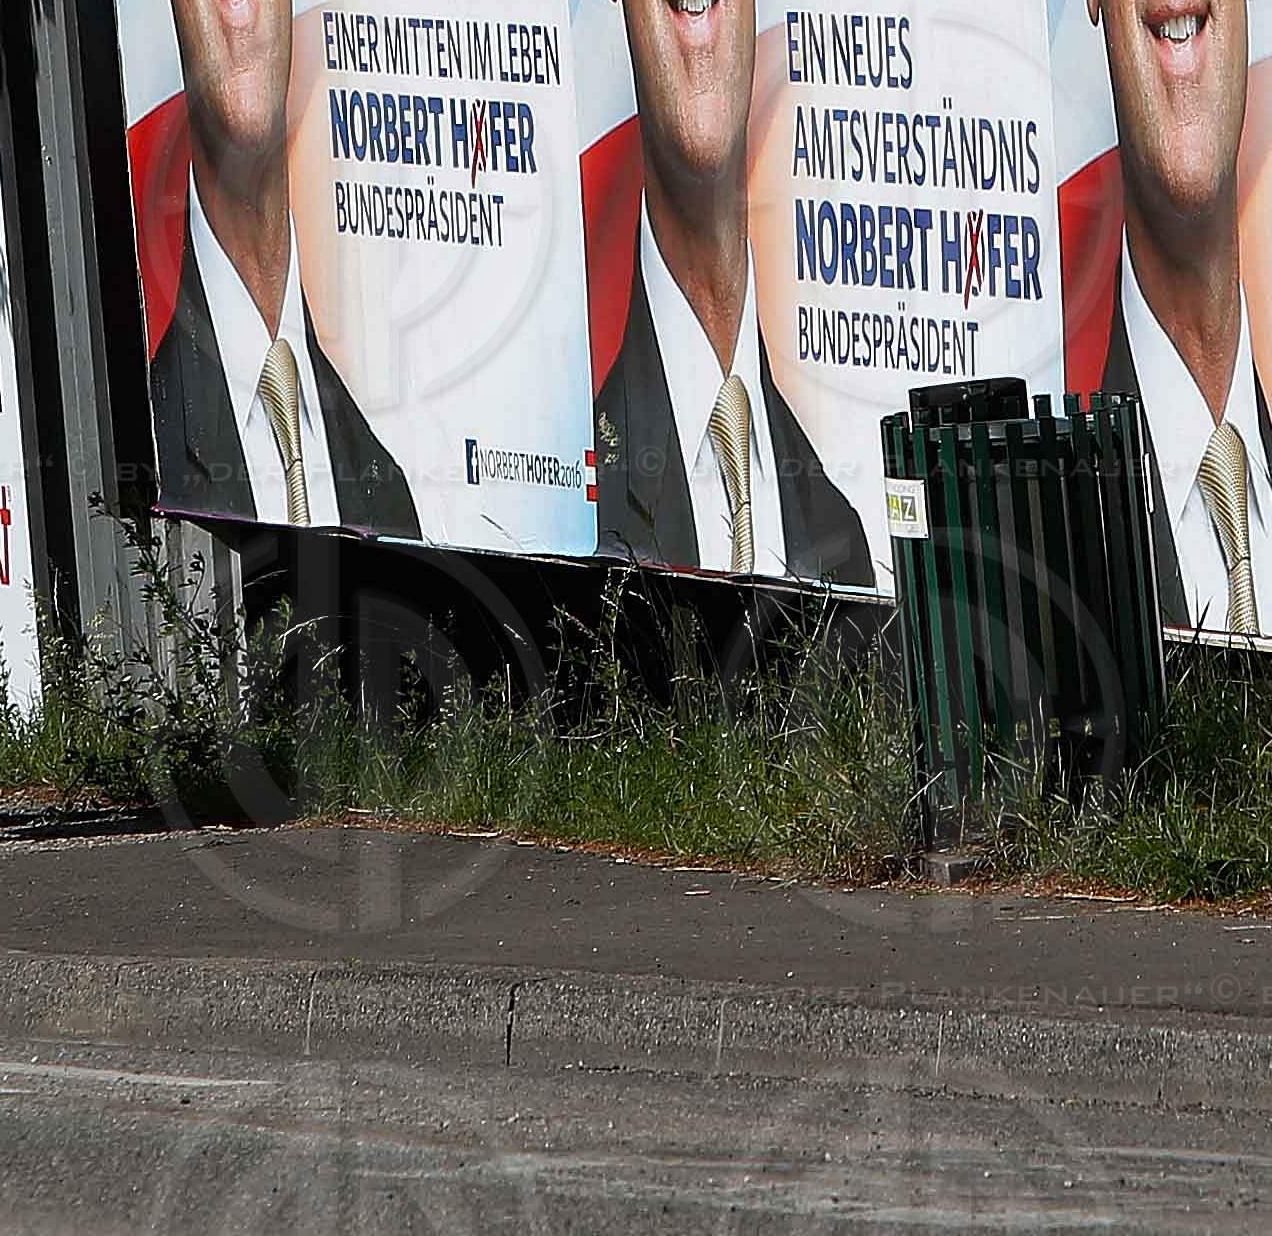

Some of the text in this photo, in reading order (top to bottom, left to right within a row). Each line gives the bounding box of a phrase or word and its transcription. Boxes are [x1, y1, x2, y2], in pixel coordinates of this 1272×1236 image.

[323, 11, 561, 86] EINER MITTEN IM LEBEN
[785, 10, 914, 90] EIN NEUES
[329, 87, 445, 168] NORBERT
[792, 97, 1040, 195] AMTSVERSTÄNDNIS
[334, 175, 505, 247] BUNDESPRÄSIDENT
[794, 198, 933, 292] NORBERT
[797, 302, 980, 377] BUNDESPRÄSIDENT
[479, 448, 582, 490] NORBERTHOFER2016
